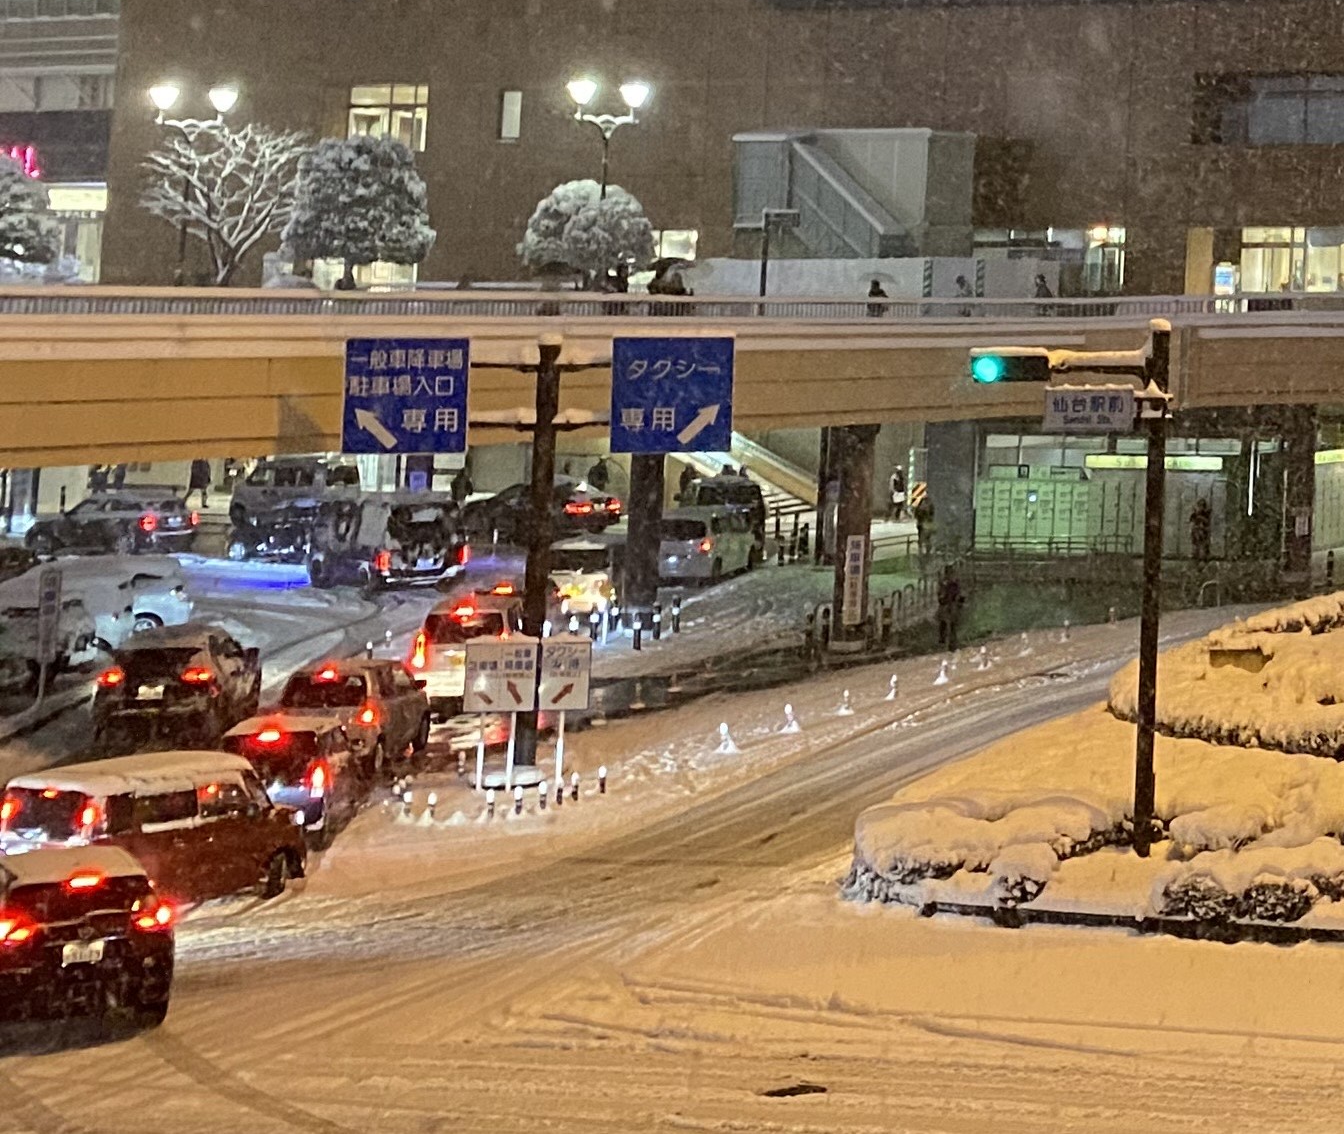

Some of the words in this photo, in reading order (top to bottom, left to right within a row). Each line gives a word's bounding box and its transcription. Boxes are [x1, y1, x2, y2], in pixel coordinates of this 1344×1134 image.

[628, 359, 721, 380] タクシー
[349, 375, 454, 397] 駐車場入口
[1053, 395, 1124, 413] 仙台駅前
[401, 408, 459, 434] 専用
[620, 407, 675, 433] 専用
